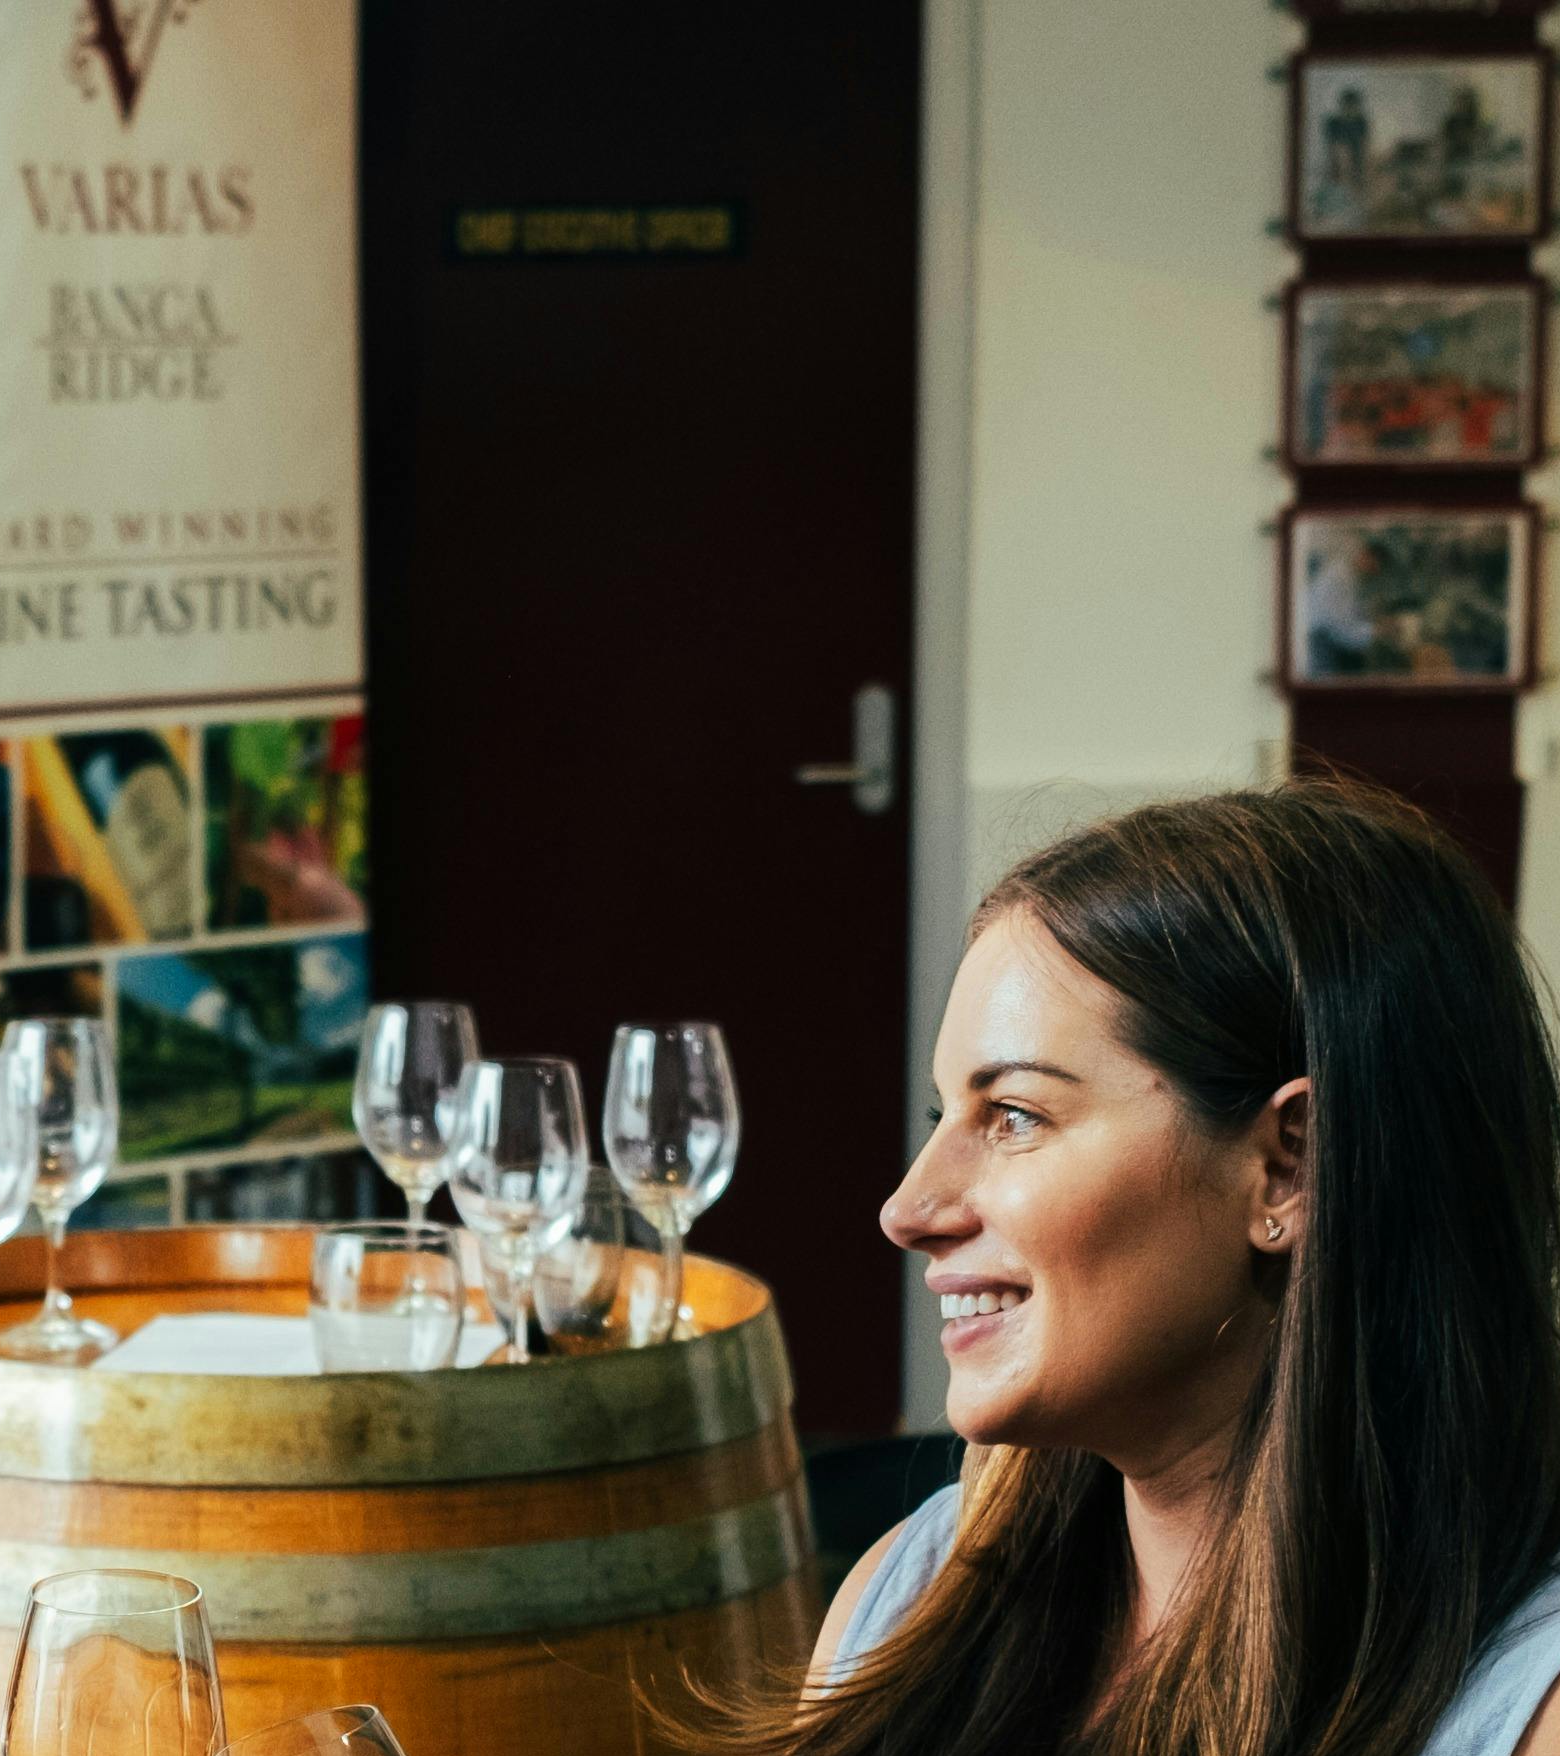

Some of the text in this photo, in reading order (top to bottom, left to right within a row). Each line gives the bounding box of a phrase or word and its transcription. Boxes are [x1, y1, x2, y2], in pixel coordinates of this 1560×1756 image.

[20, 163, 256, 236] VARIAS
[48, 348, 225, 402] RIDGE
[113, 502, 340, 550] WINNING
[98, 568, 340, 640] TASTING
